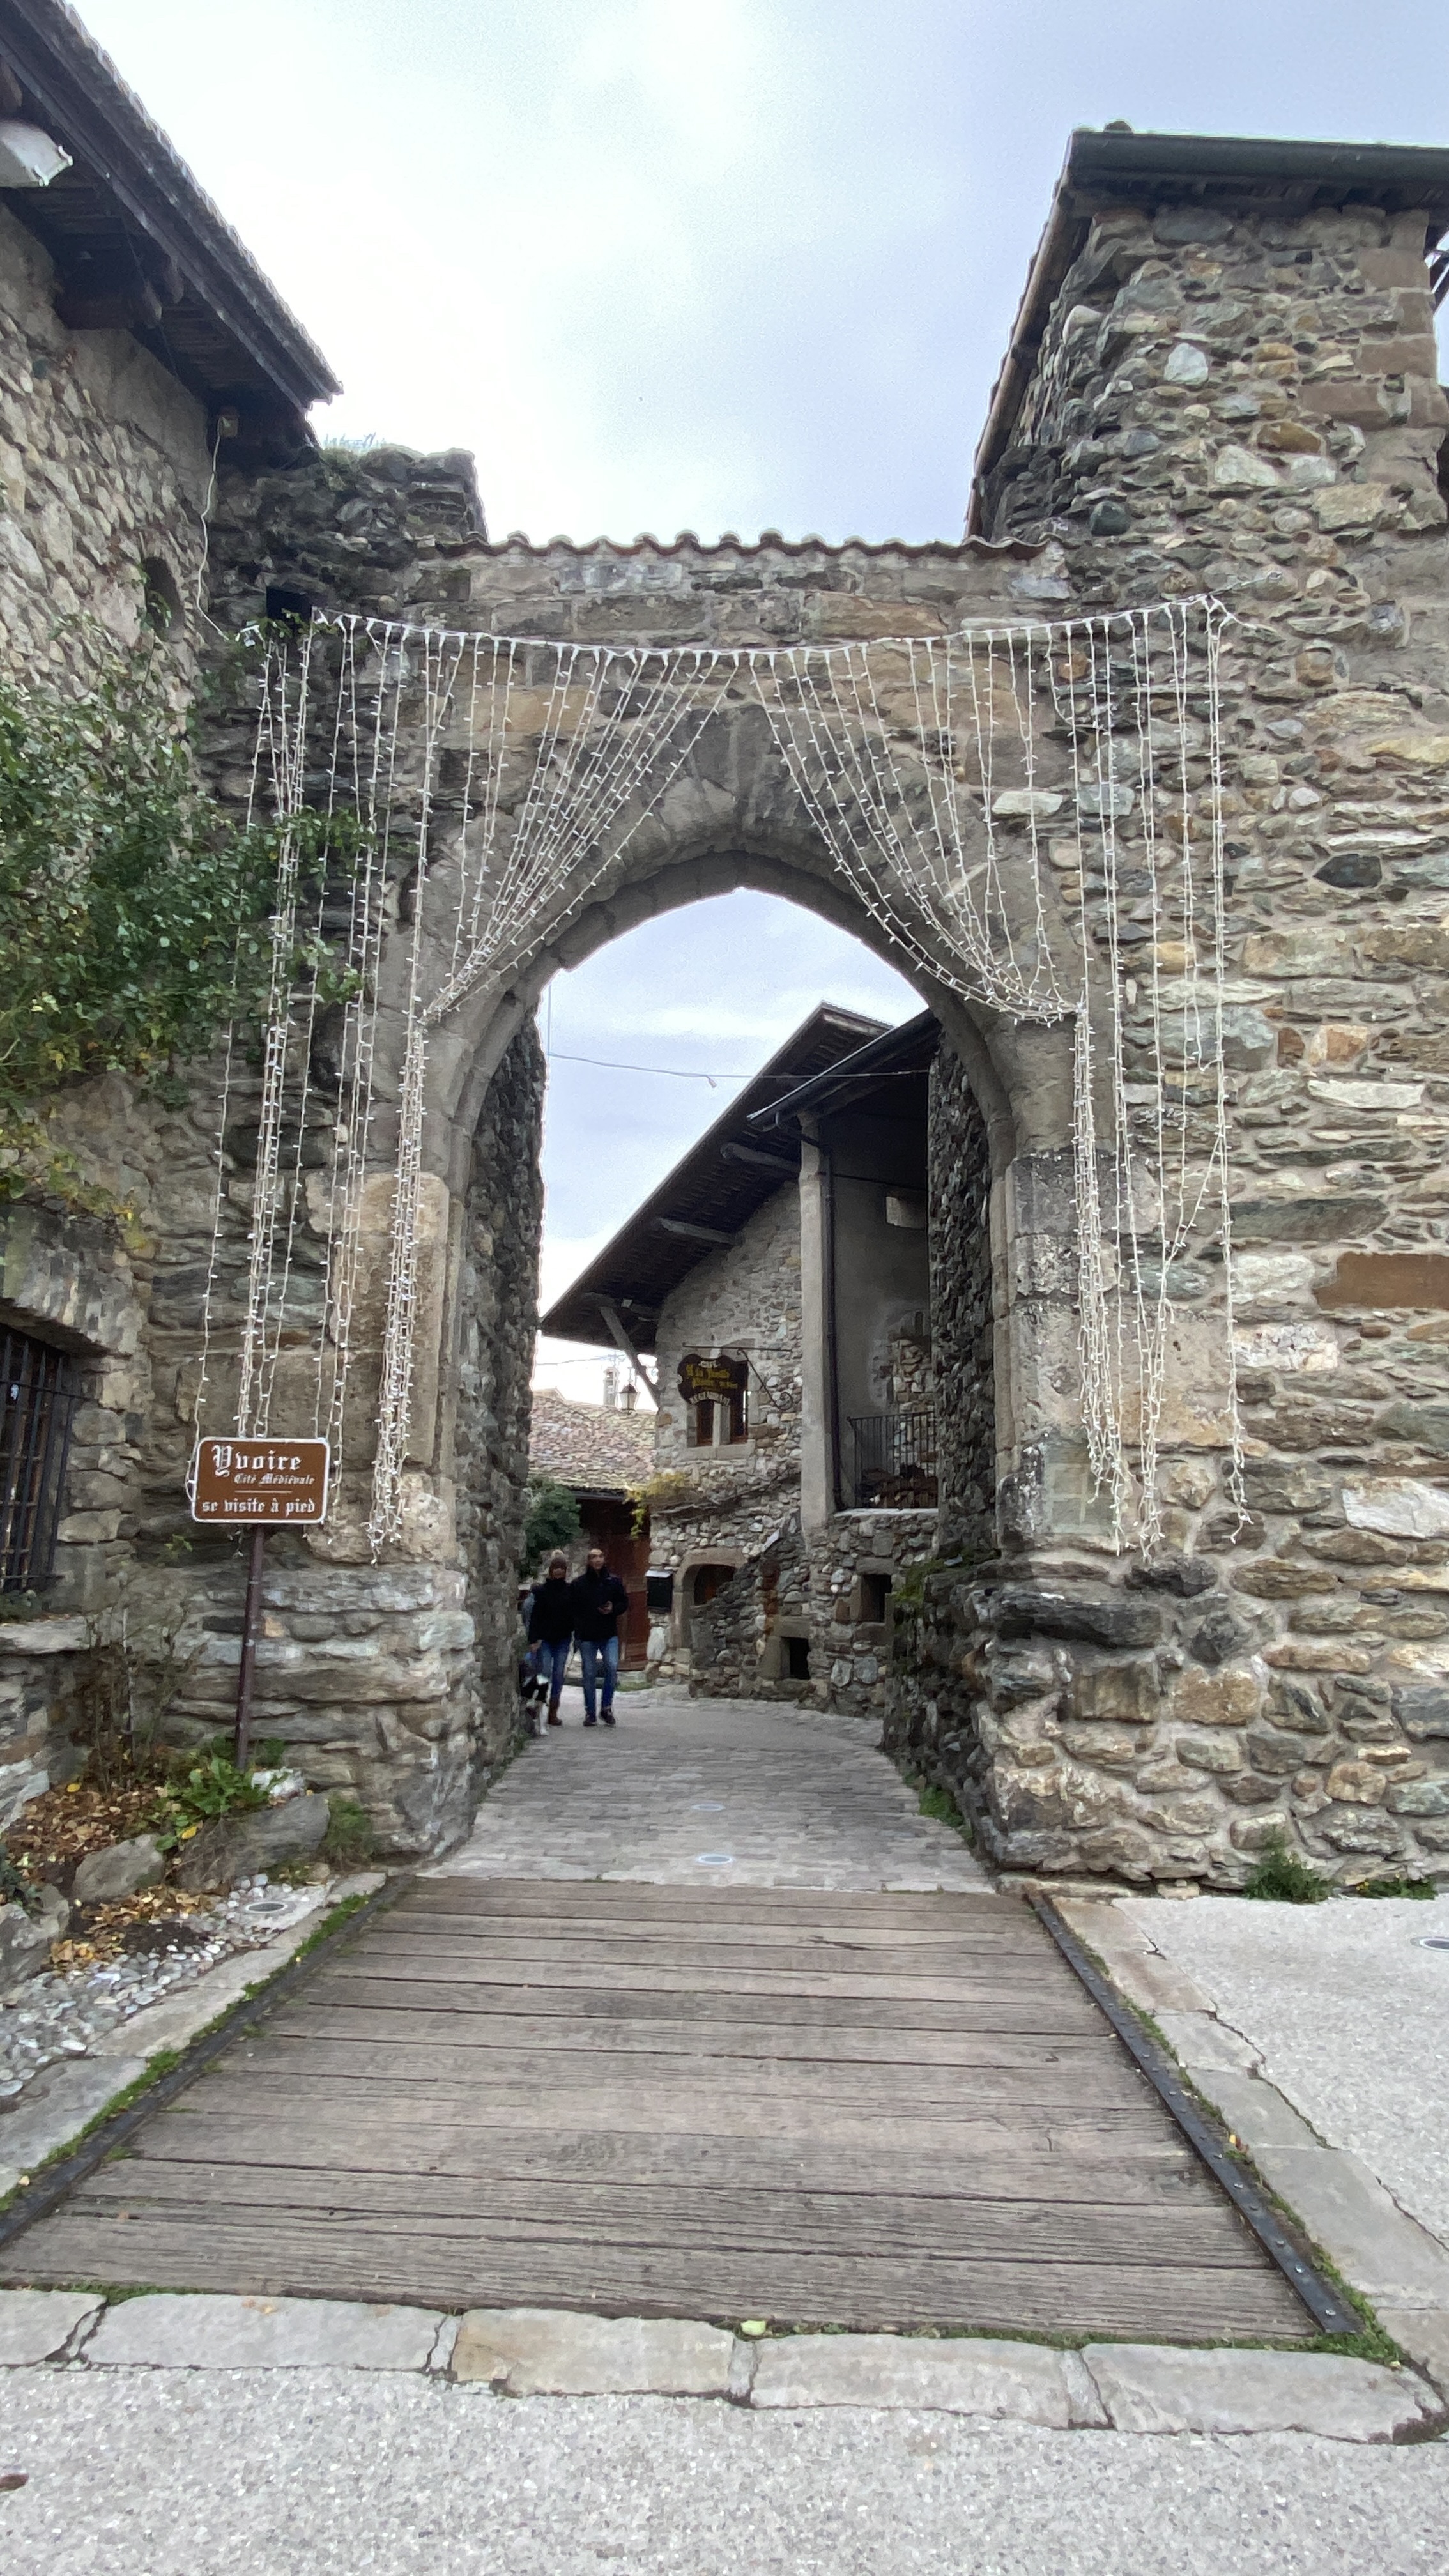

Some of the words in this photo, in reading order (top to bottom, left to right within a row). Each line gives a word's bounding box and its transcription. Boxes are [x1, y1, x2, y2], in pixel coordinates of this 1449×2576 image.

[211, 1444, 302, 1477] Yvoire
[234, 1473, 257, 1484] Cité
[202, 1501, 218, 1512] se
[224, 1497, 266, 1513] visite
[270, 1498, 279, 1513] à
[285, 1498, 316, 1518] pied
